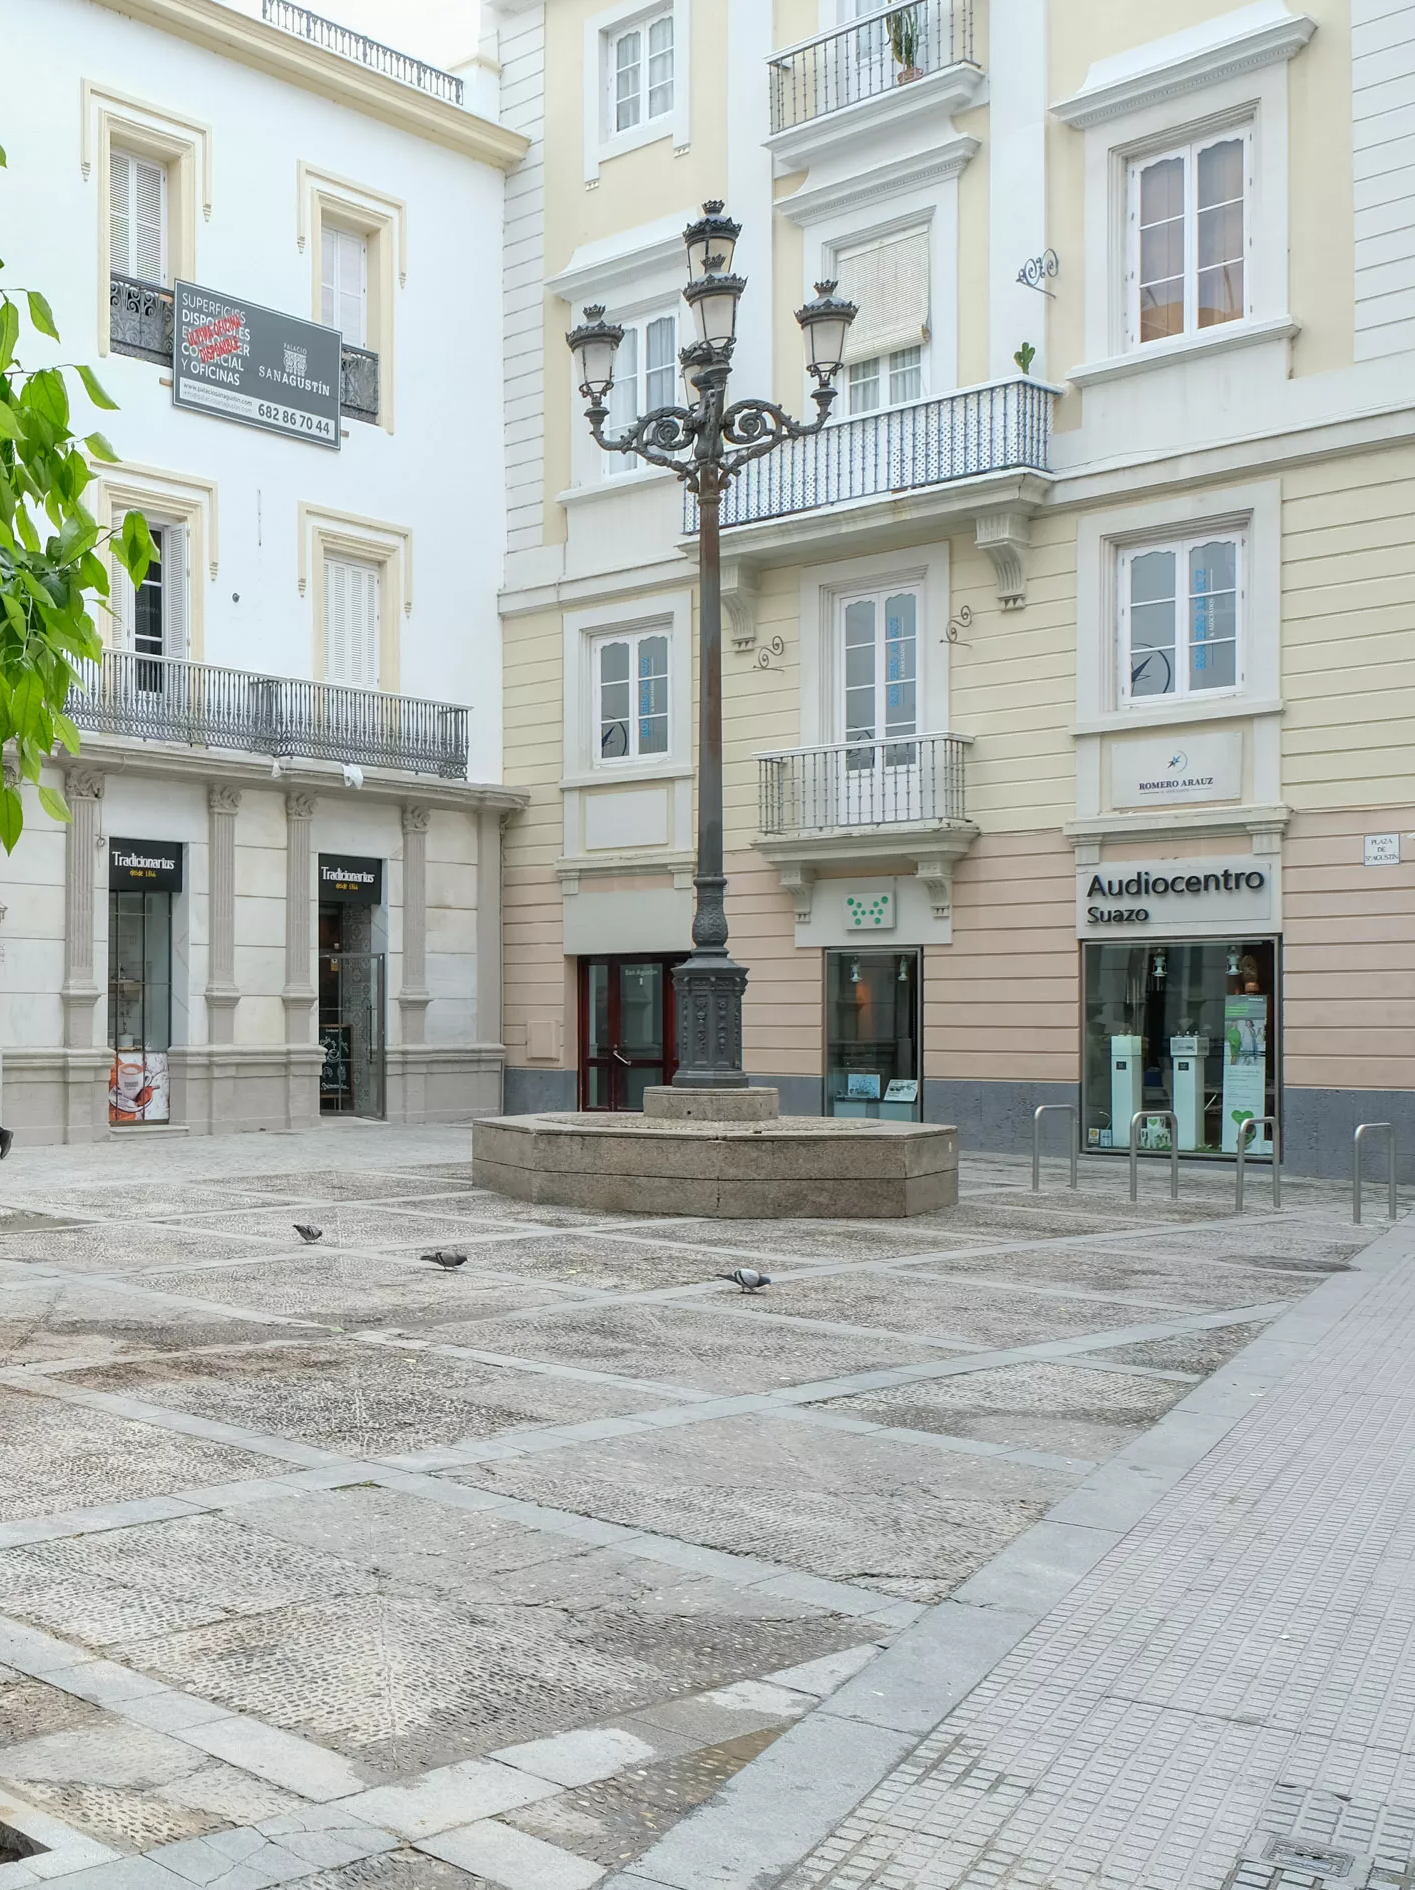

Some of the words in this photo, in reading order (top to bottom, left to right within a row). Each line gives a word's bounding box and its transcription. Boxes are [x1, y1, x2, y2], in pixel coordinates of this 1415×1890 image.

[284, 343, 307, 355] PALACIO
[181, 357, 189, 371] Y
[190, 361, 241, 387] OFICINAS
[258, 403, 280, 422] 682
[282, 410, 297, 426] 86
[299, 414, 313, 431] 70
[315, 420, 330, 435] 44
[1139, 780, 1179, 790] ROMERO
[1181, 777, 1214, 788] ARAUZ
[1370, 838, 1393, 846] PLAZA
[112, 851, 175, 870] Tradicionarius
[321, 866, 375, 883] Tradicionarius
[1087, 870, 1266, 898] Audiocentro
[1087, 906, 1150, 924] Suazo
